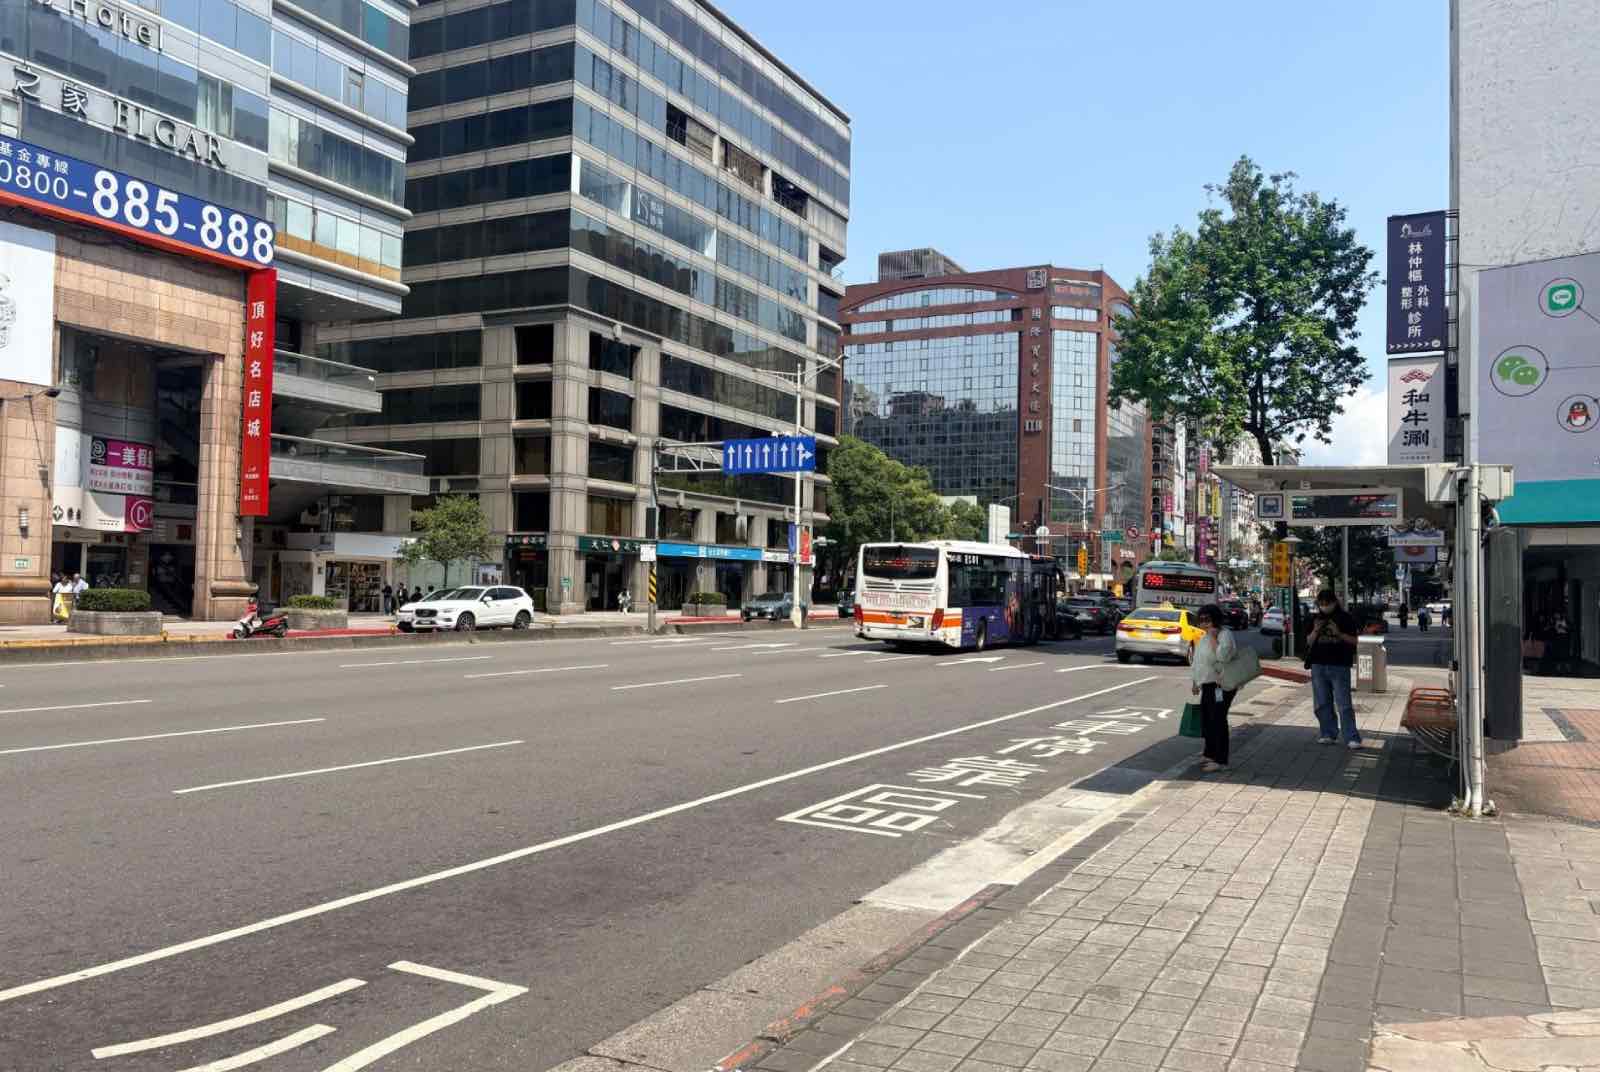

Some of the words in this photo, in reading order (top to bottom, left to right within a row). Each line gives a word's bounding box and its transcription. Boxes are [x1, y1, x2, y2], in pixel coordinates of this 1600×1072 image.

[69, 0, 164, 49] Hotel
[0, 159, 275, 265] 0800-885-888
[247, 301, 265, 437] 頂好名店城
[1401, 388, 1429, 447] 和牛涮
[776, 705, 1175, 838] 公車停靠區
